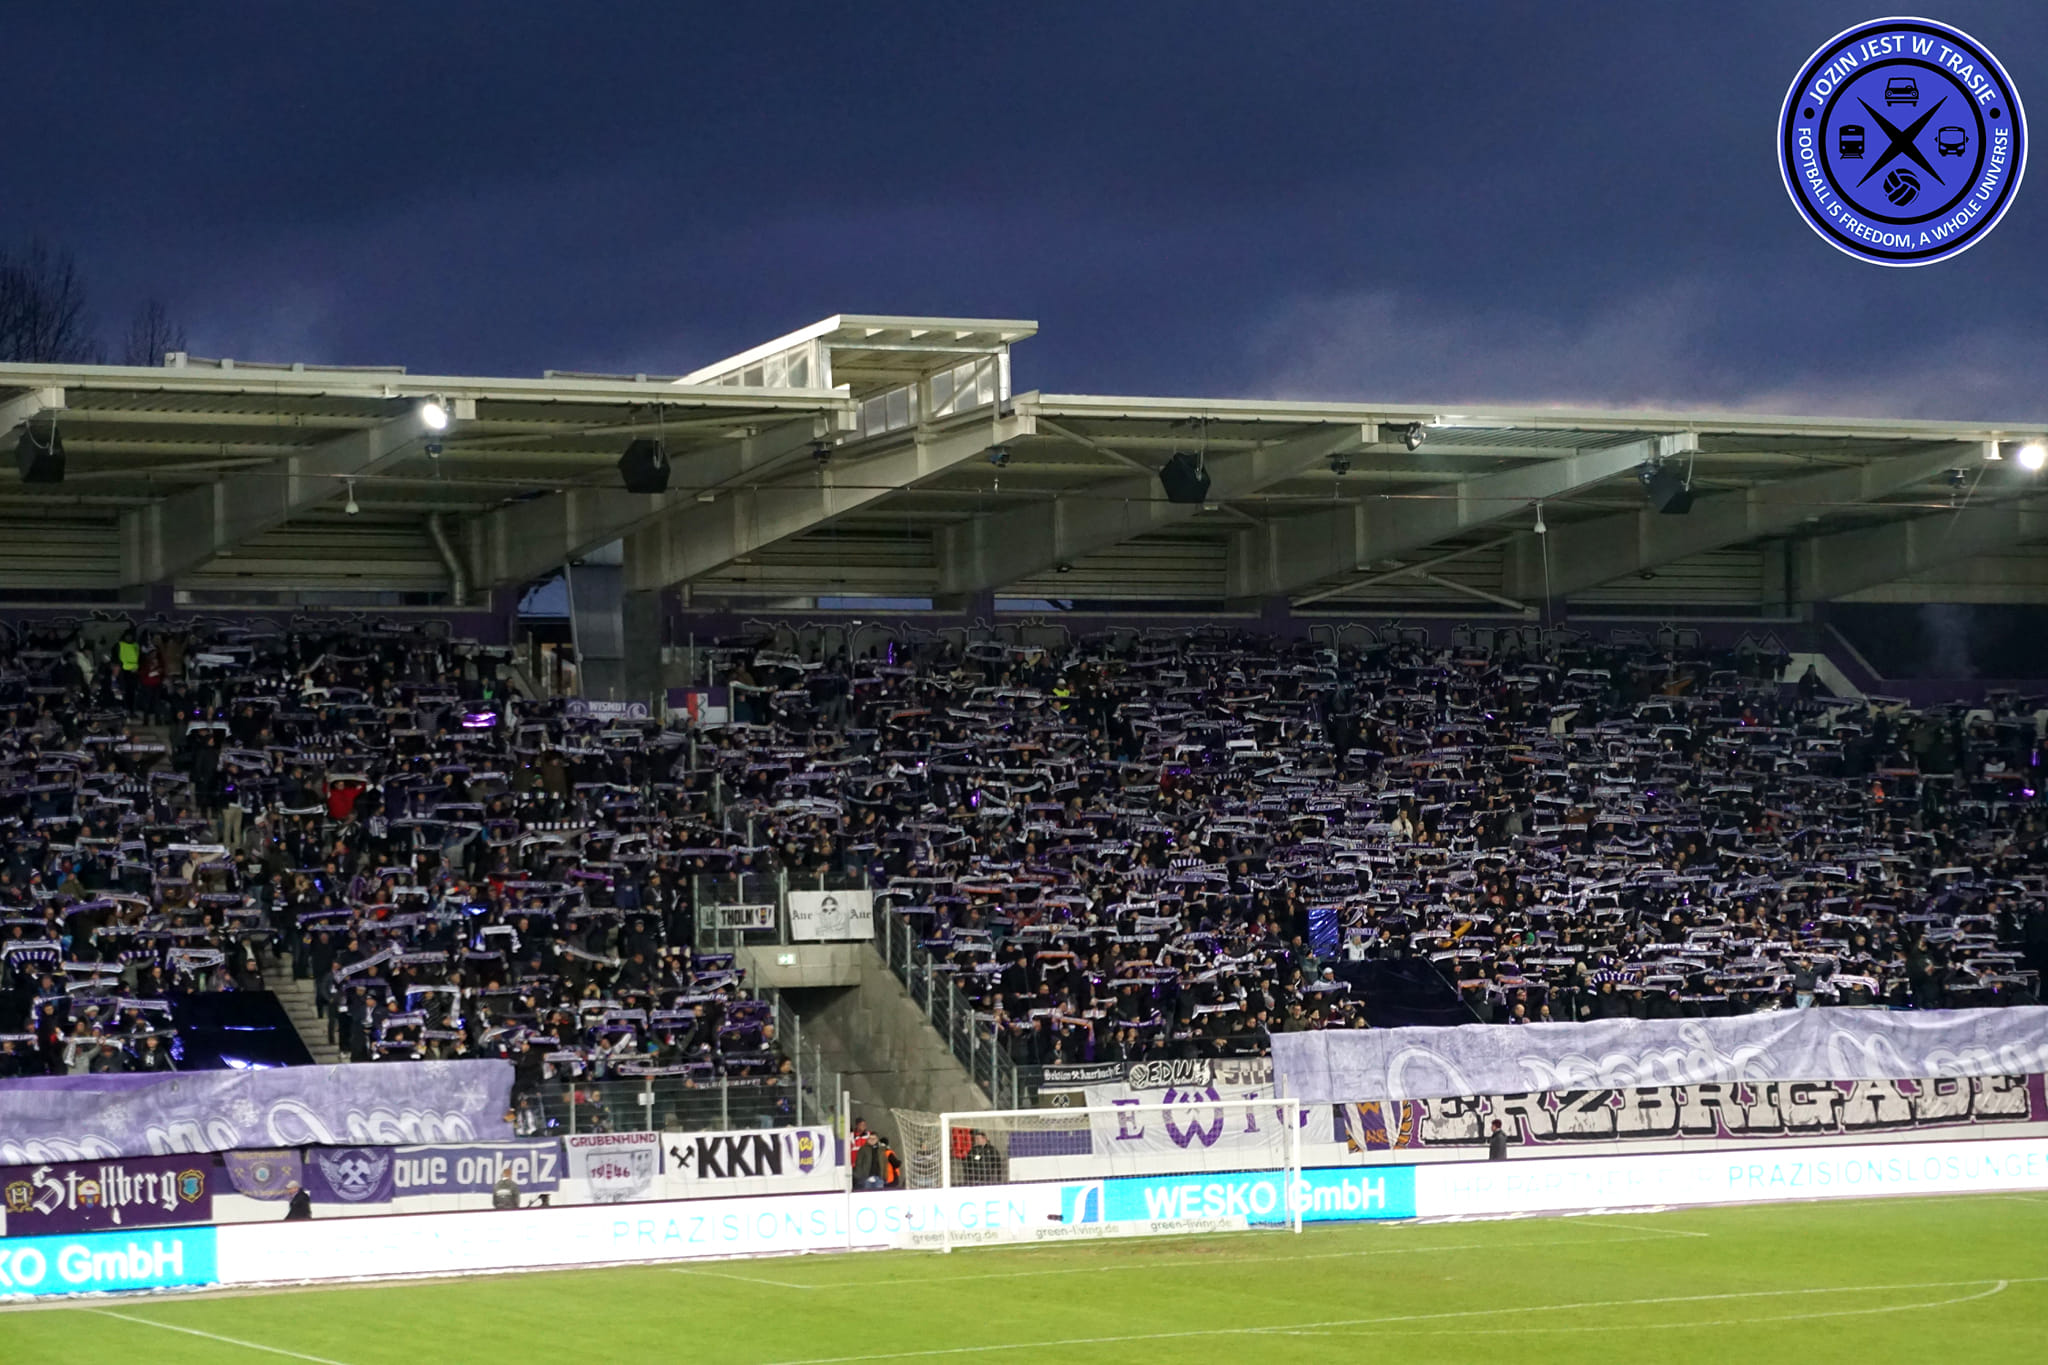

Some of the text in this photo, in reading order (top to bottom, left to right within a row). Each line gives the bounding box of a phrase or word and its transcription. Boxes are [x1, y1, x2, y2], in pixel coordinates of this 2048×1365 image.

[1418, 1074, 2032, 1146] ERZBRIGADE
[570, 1133, 657, 1148] GRUBENHUND
[695, 1132, 783, 1179] KKN
[456, 1150, 557, 1185] onkelz
[1728, 1151, 2048, 1189] PRAZISIONSLOSUNGE
[1145, 1176, 1386, 1220] WESKO GmbH
[911, 1230, 1000, 1247] greenliving.de
[1035, 1223, 1120, 1241] green-living.de
[1150, 1216, 1233, 1233] green-living.de
[57, 1239, 184, 1284] GmbH
